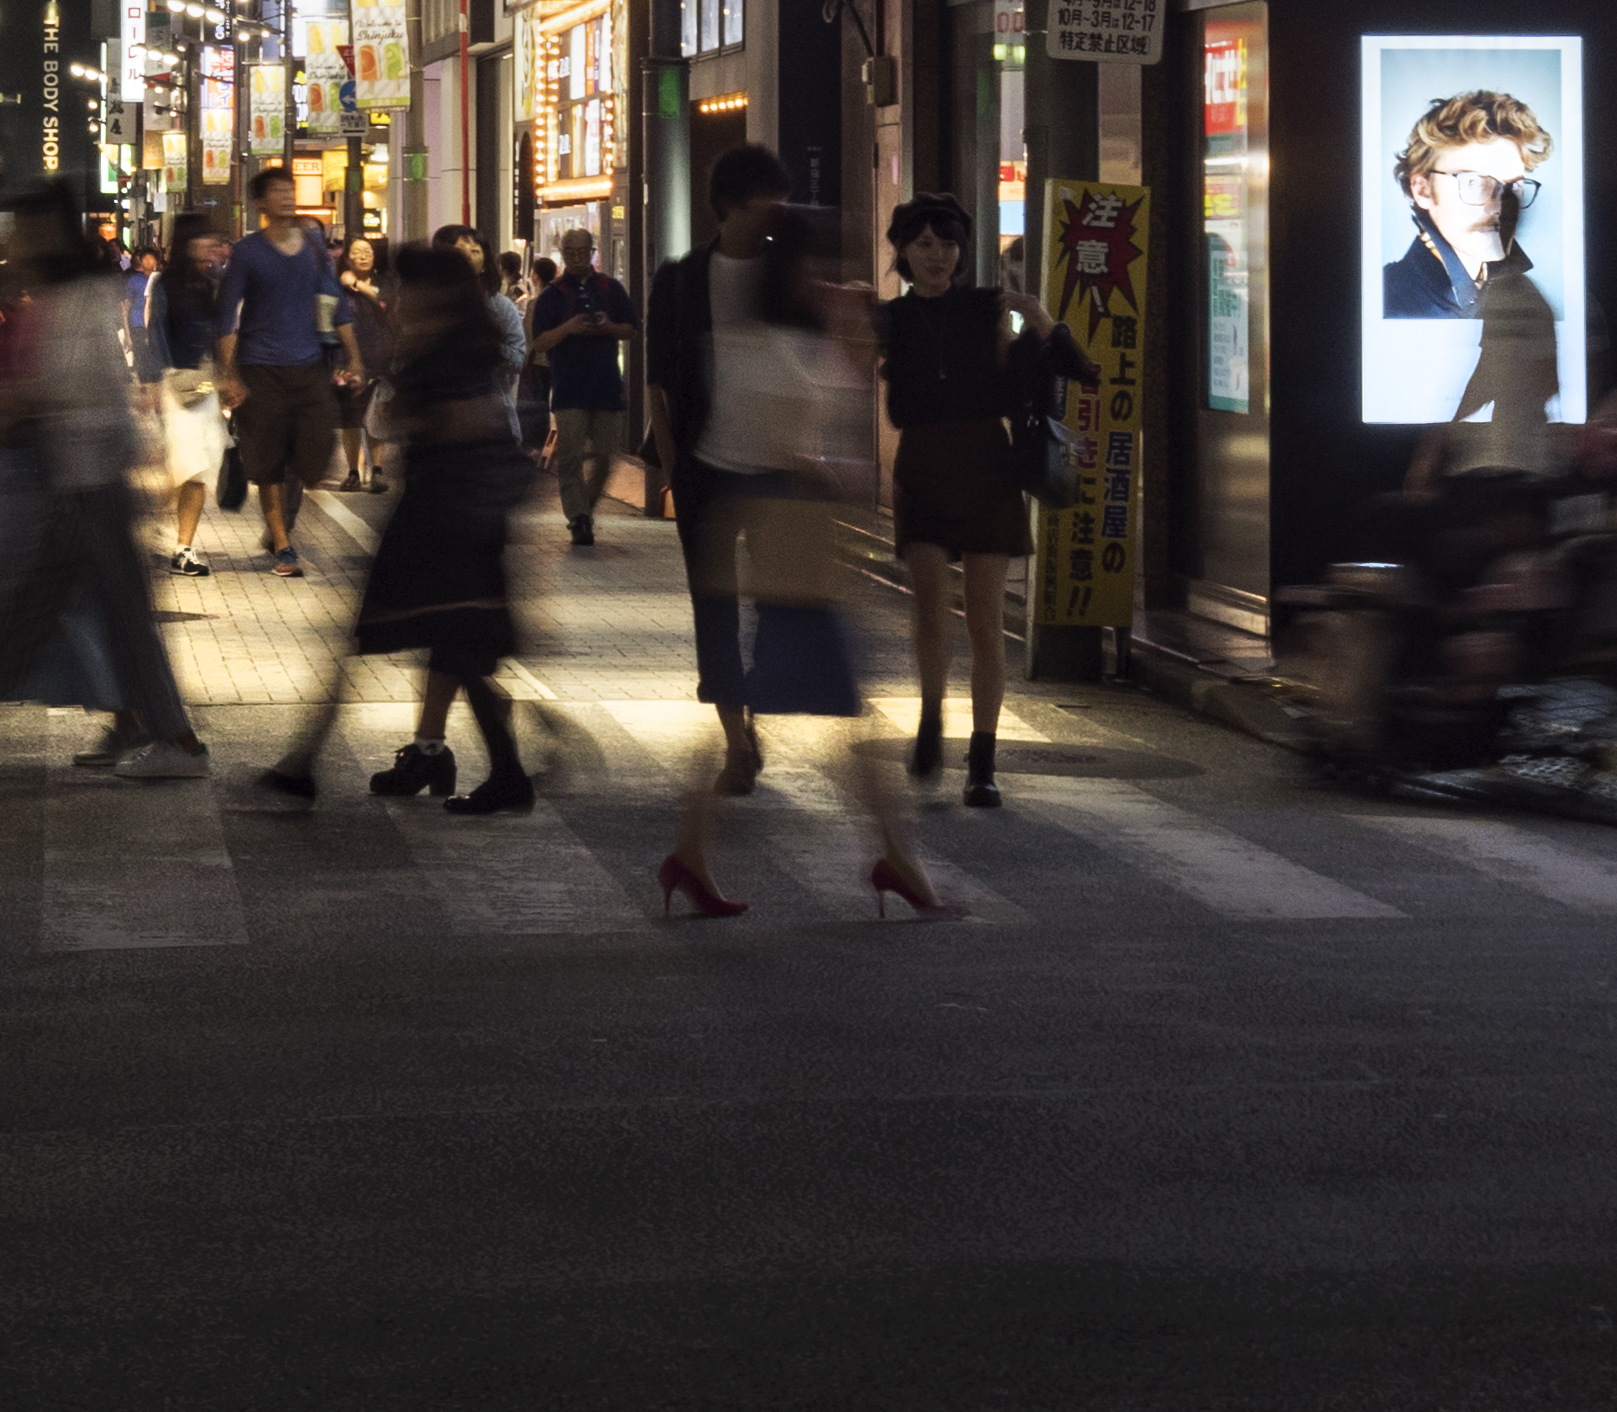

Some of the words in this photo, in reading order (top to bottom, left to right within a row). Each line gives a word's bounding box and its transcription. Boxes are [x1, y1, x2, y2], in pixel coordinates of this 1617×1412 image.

[44, 15, 59, 53] THE
[43, 60, 59, 113] BODY
[1101, 314, 1136, 575] 路上の居酒屋の
